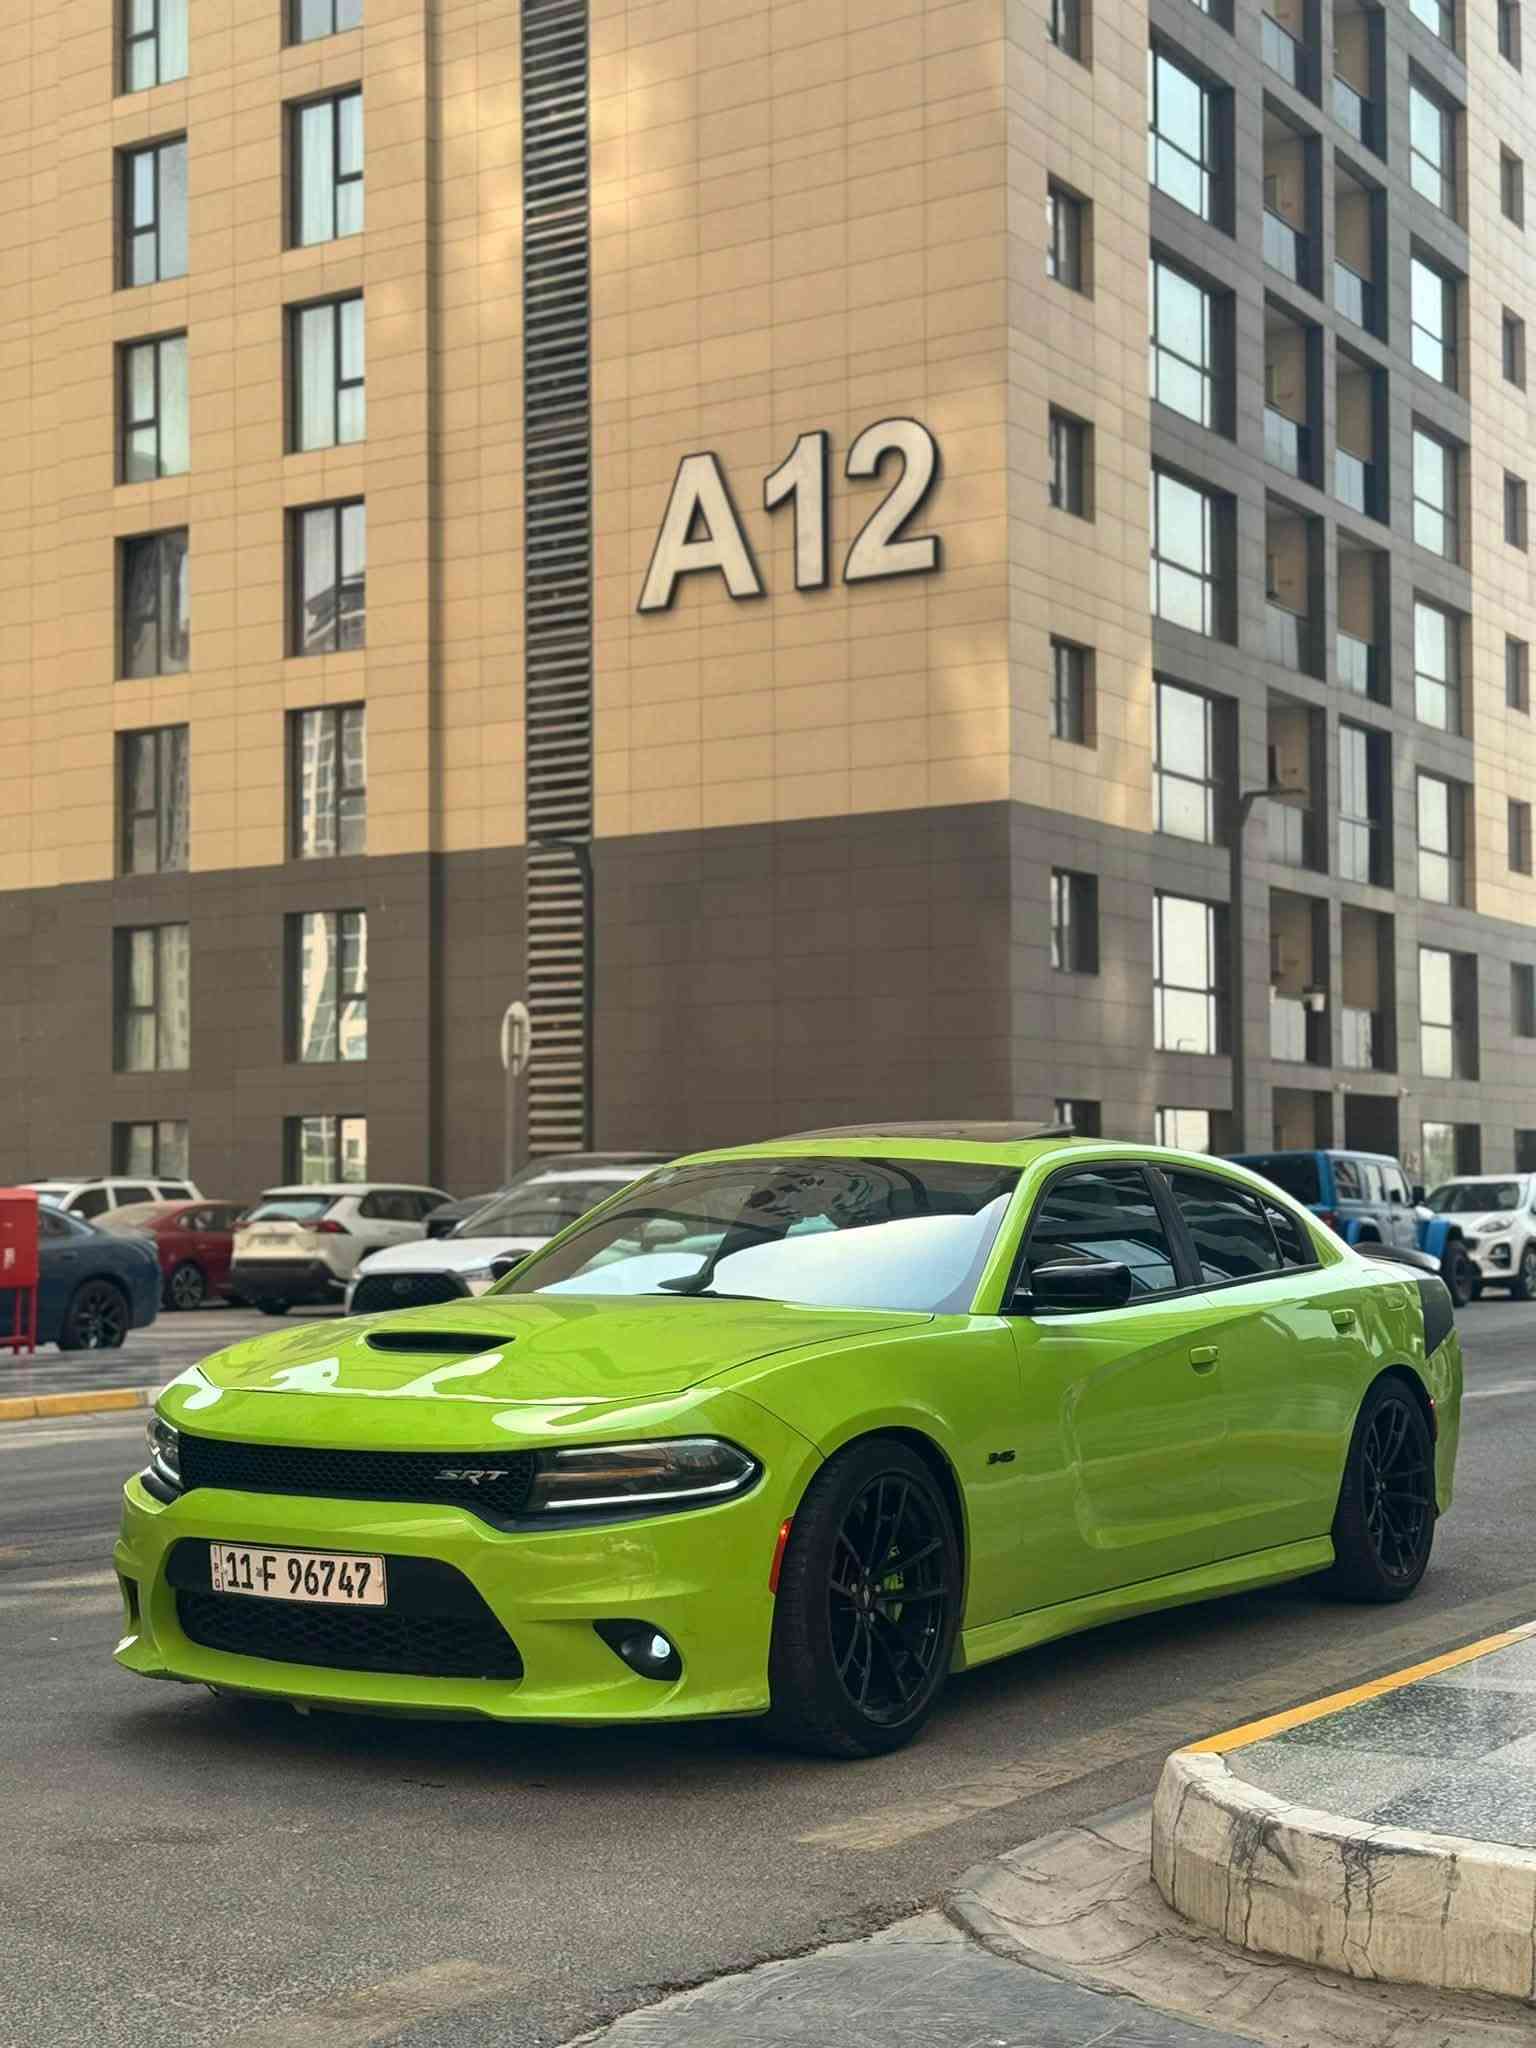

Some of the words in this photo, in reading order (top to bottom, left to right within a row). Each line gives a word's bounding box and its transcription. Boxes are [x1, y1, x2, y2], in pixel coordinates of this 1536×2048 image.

[637, 416, 942, 614] A12
[434, 1470, 509, 1485] SRT
[287, 1558, 371, 1599] 96747
